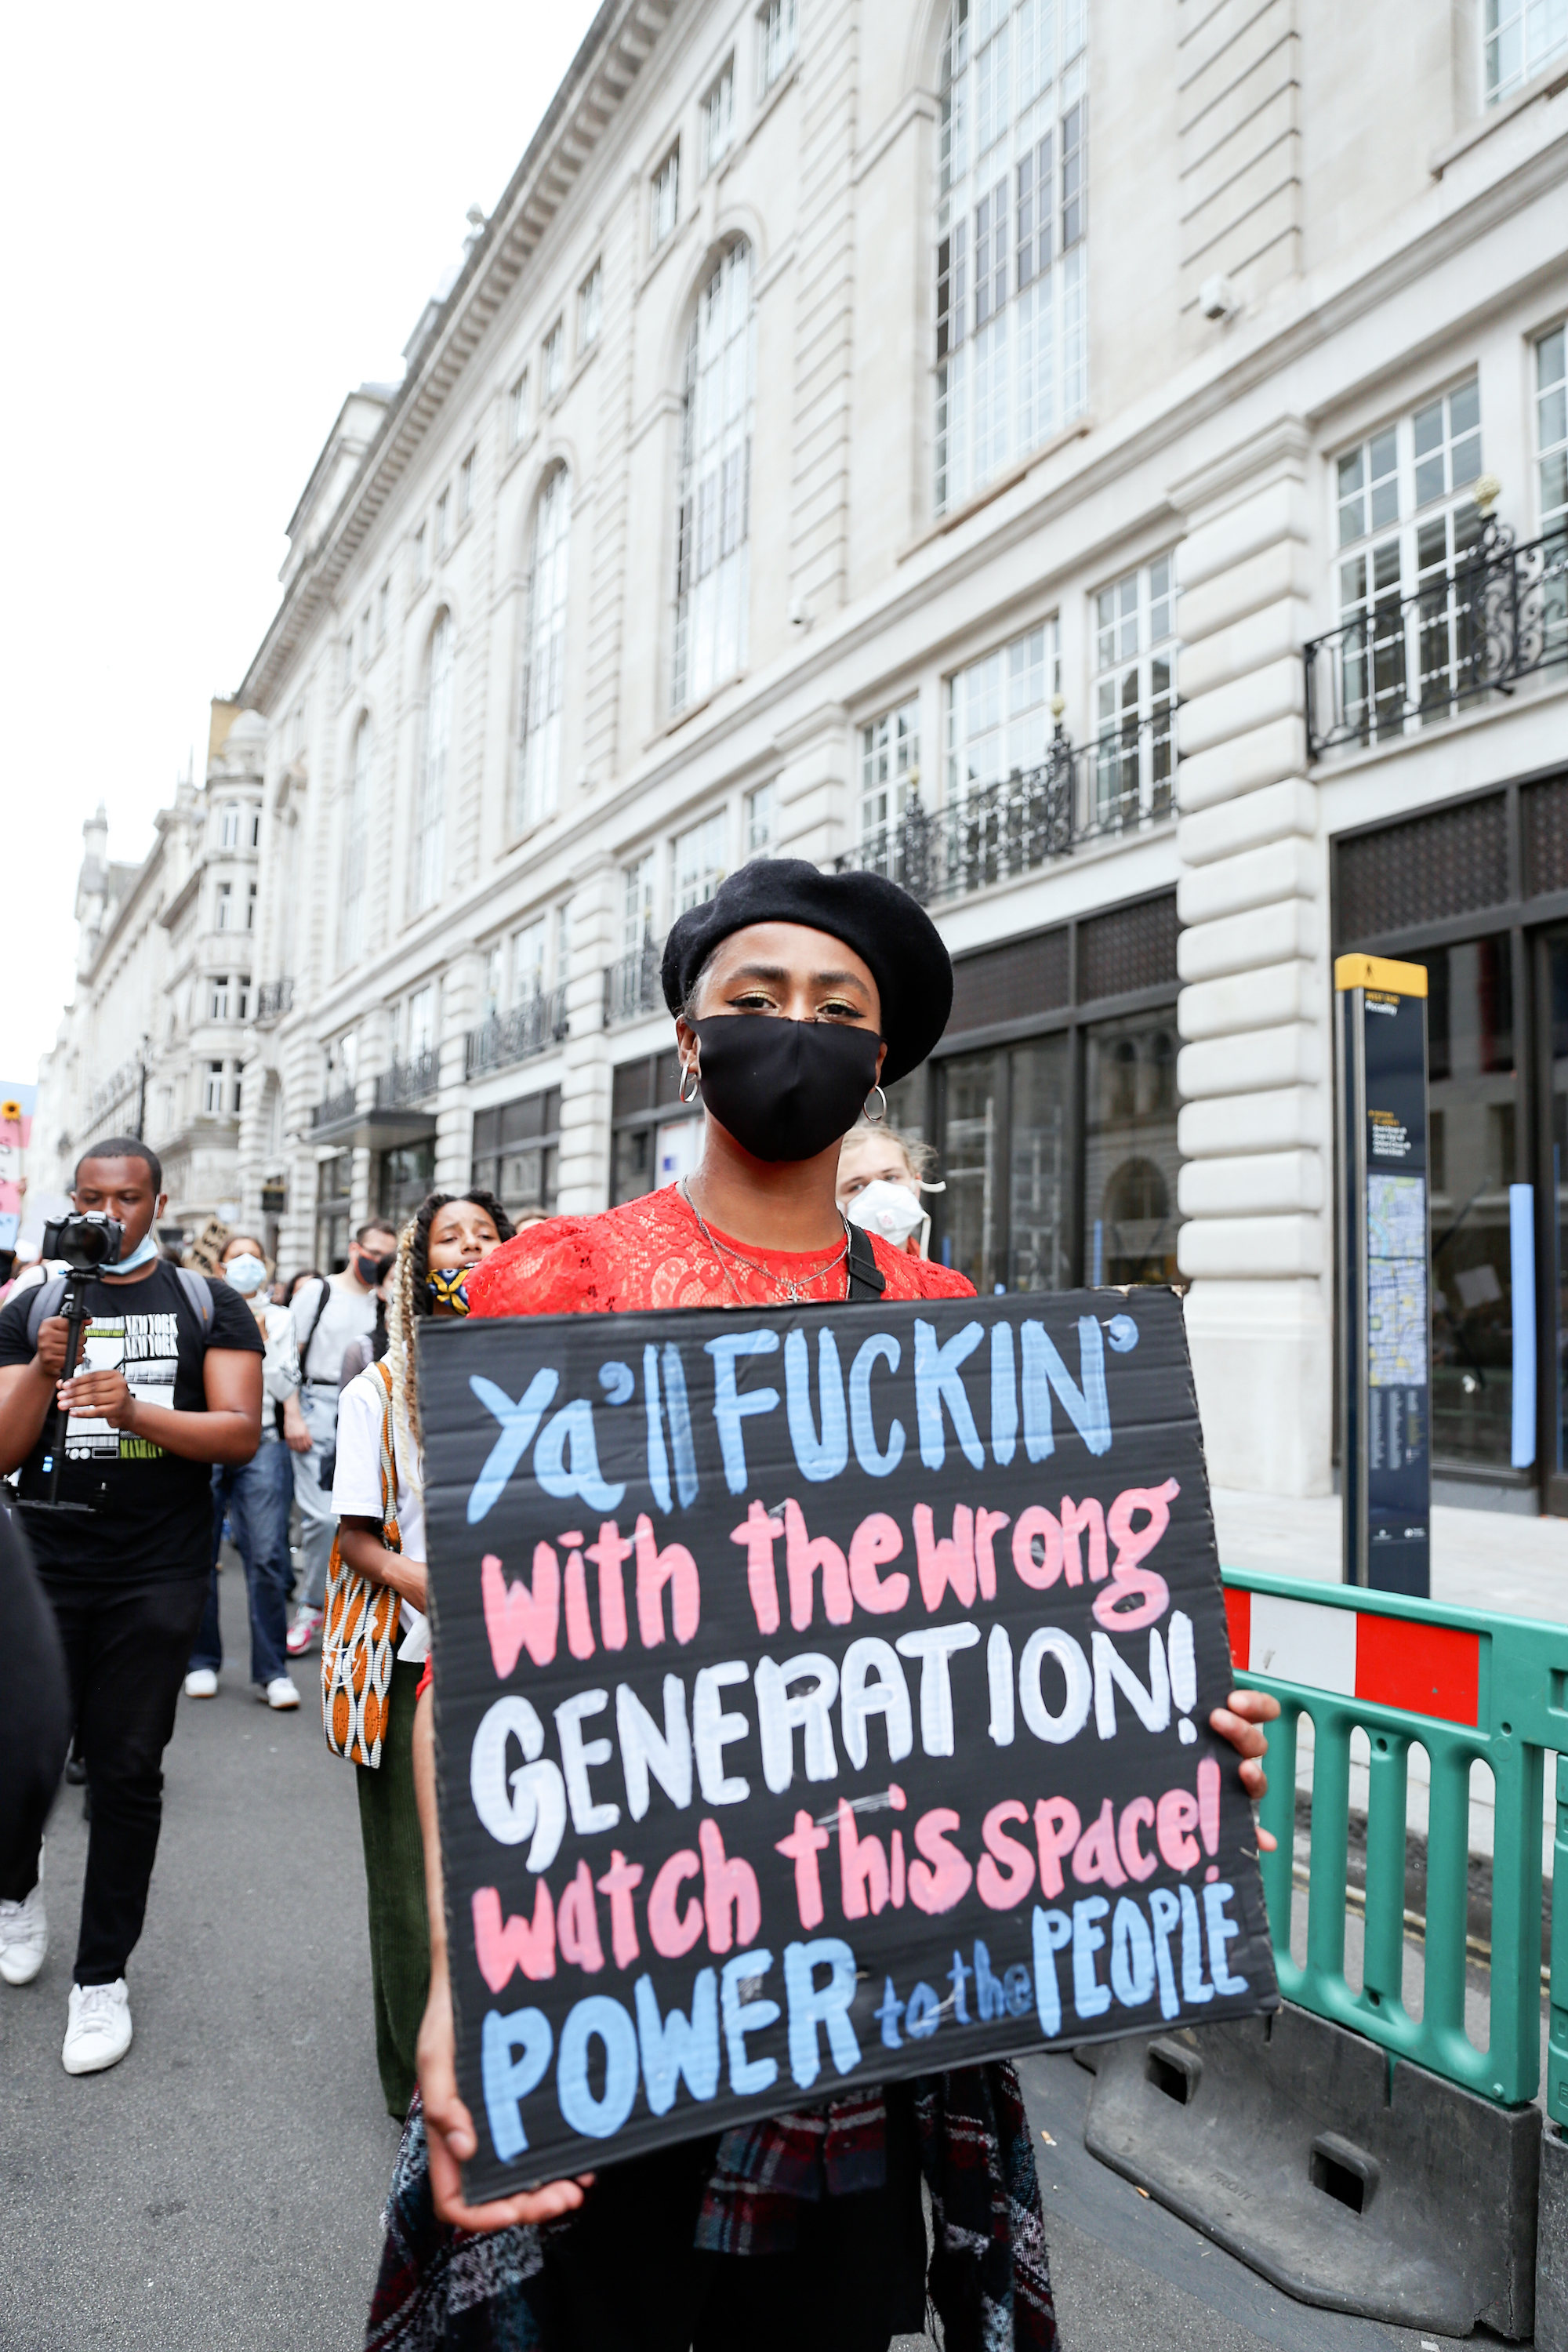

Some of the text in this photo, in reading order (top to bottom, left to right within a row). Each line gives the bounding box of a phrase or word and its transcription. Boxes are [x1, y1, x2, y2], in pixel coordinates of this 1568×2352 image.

[703, 1312, 1139, 1495] FUCKIN'
[911, 1476, 1181, 1633] wrong
[470, 1610, 1199, 1874] GENERATION!
[481, 1882, 1250, 2165] POWER to the PEOPLE
[1210, 2171, 1256, 2201] FRONT
